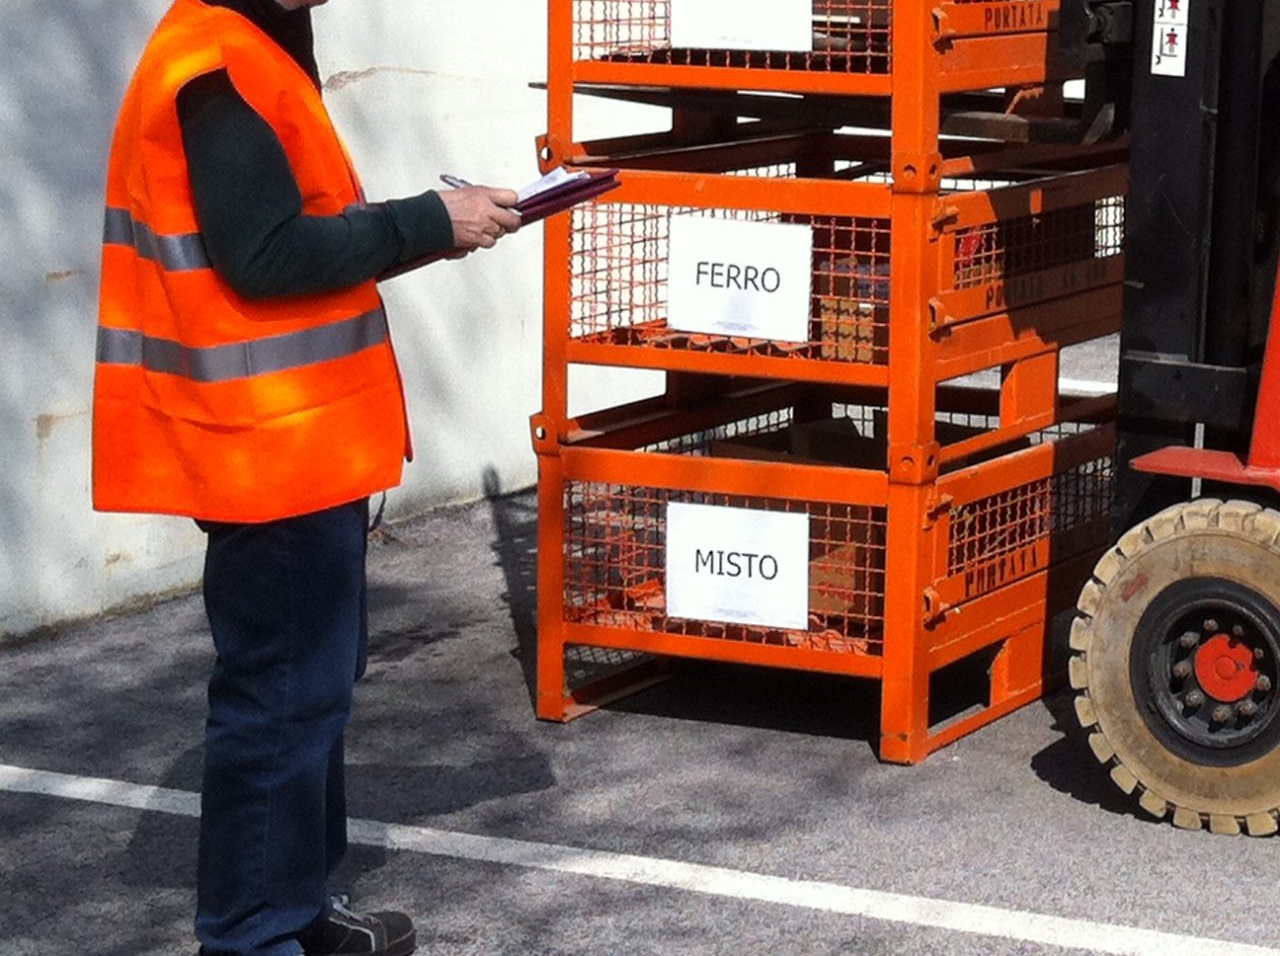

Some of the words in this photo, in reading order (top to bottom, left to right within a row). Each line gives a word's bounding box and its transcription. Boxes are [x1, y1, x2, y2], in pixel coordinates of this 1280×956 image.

[984, 3, 1044, 30] PORTATA
[695, 261, 781, 293] FERRO
[694, 548, 778, 581] MISTO
